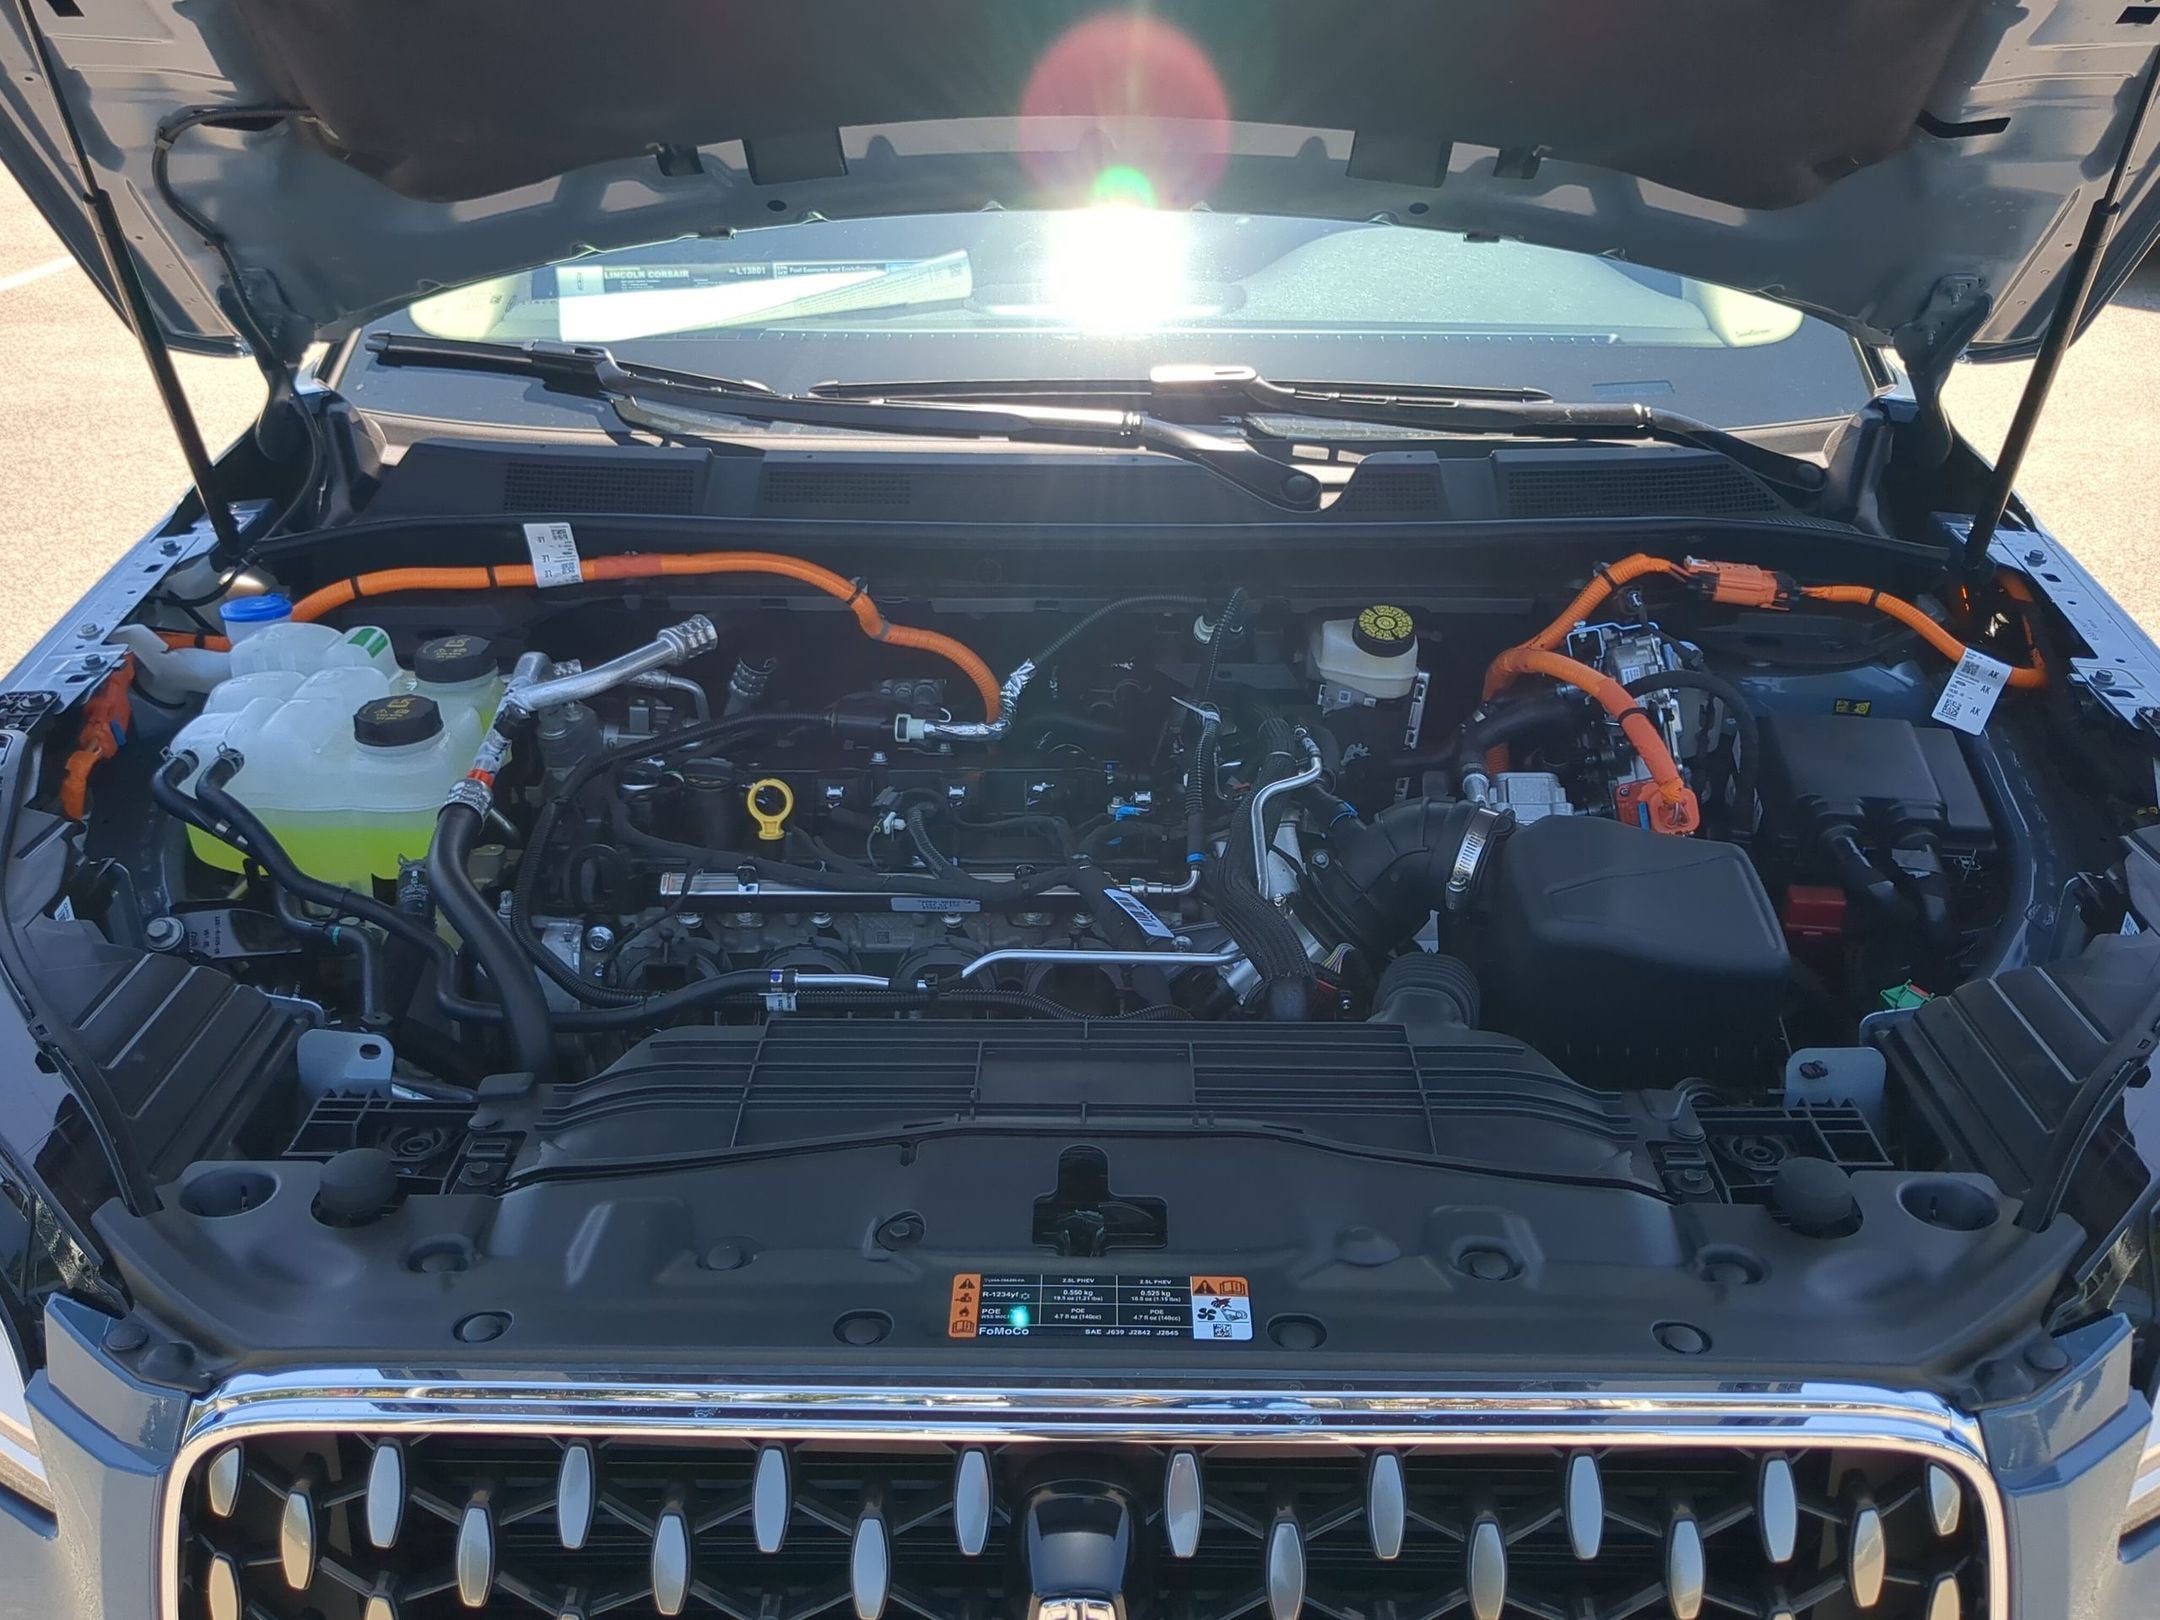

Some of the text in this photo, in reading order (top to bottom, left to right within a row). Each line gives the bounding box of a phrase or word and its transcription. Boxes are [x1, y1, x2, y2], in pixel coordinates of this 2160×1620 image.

[604, 269, 690, 280] LINCOLN CORSAIR
[1988, 670, 2000, 680] AK
[1980, 685, 1992, 695] AK
[1970, 706, 1981, 717] AK
[982, 1291, 1019, 1299] R-1234yf
[1161, 1290, 1171, 1298] kg
[979, 1326, 1030, 1336] FoMoCo
[1085, 1328, 1102, 1336] SAE
